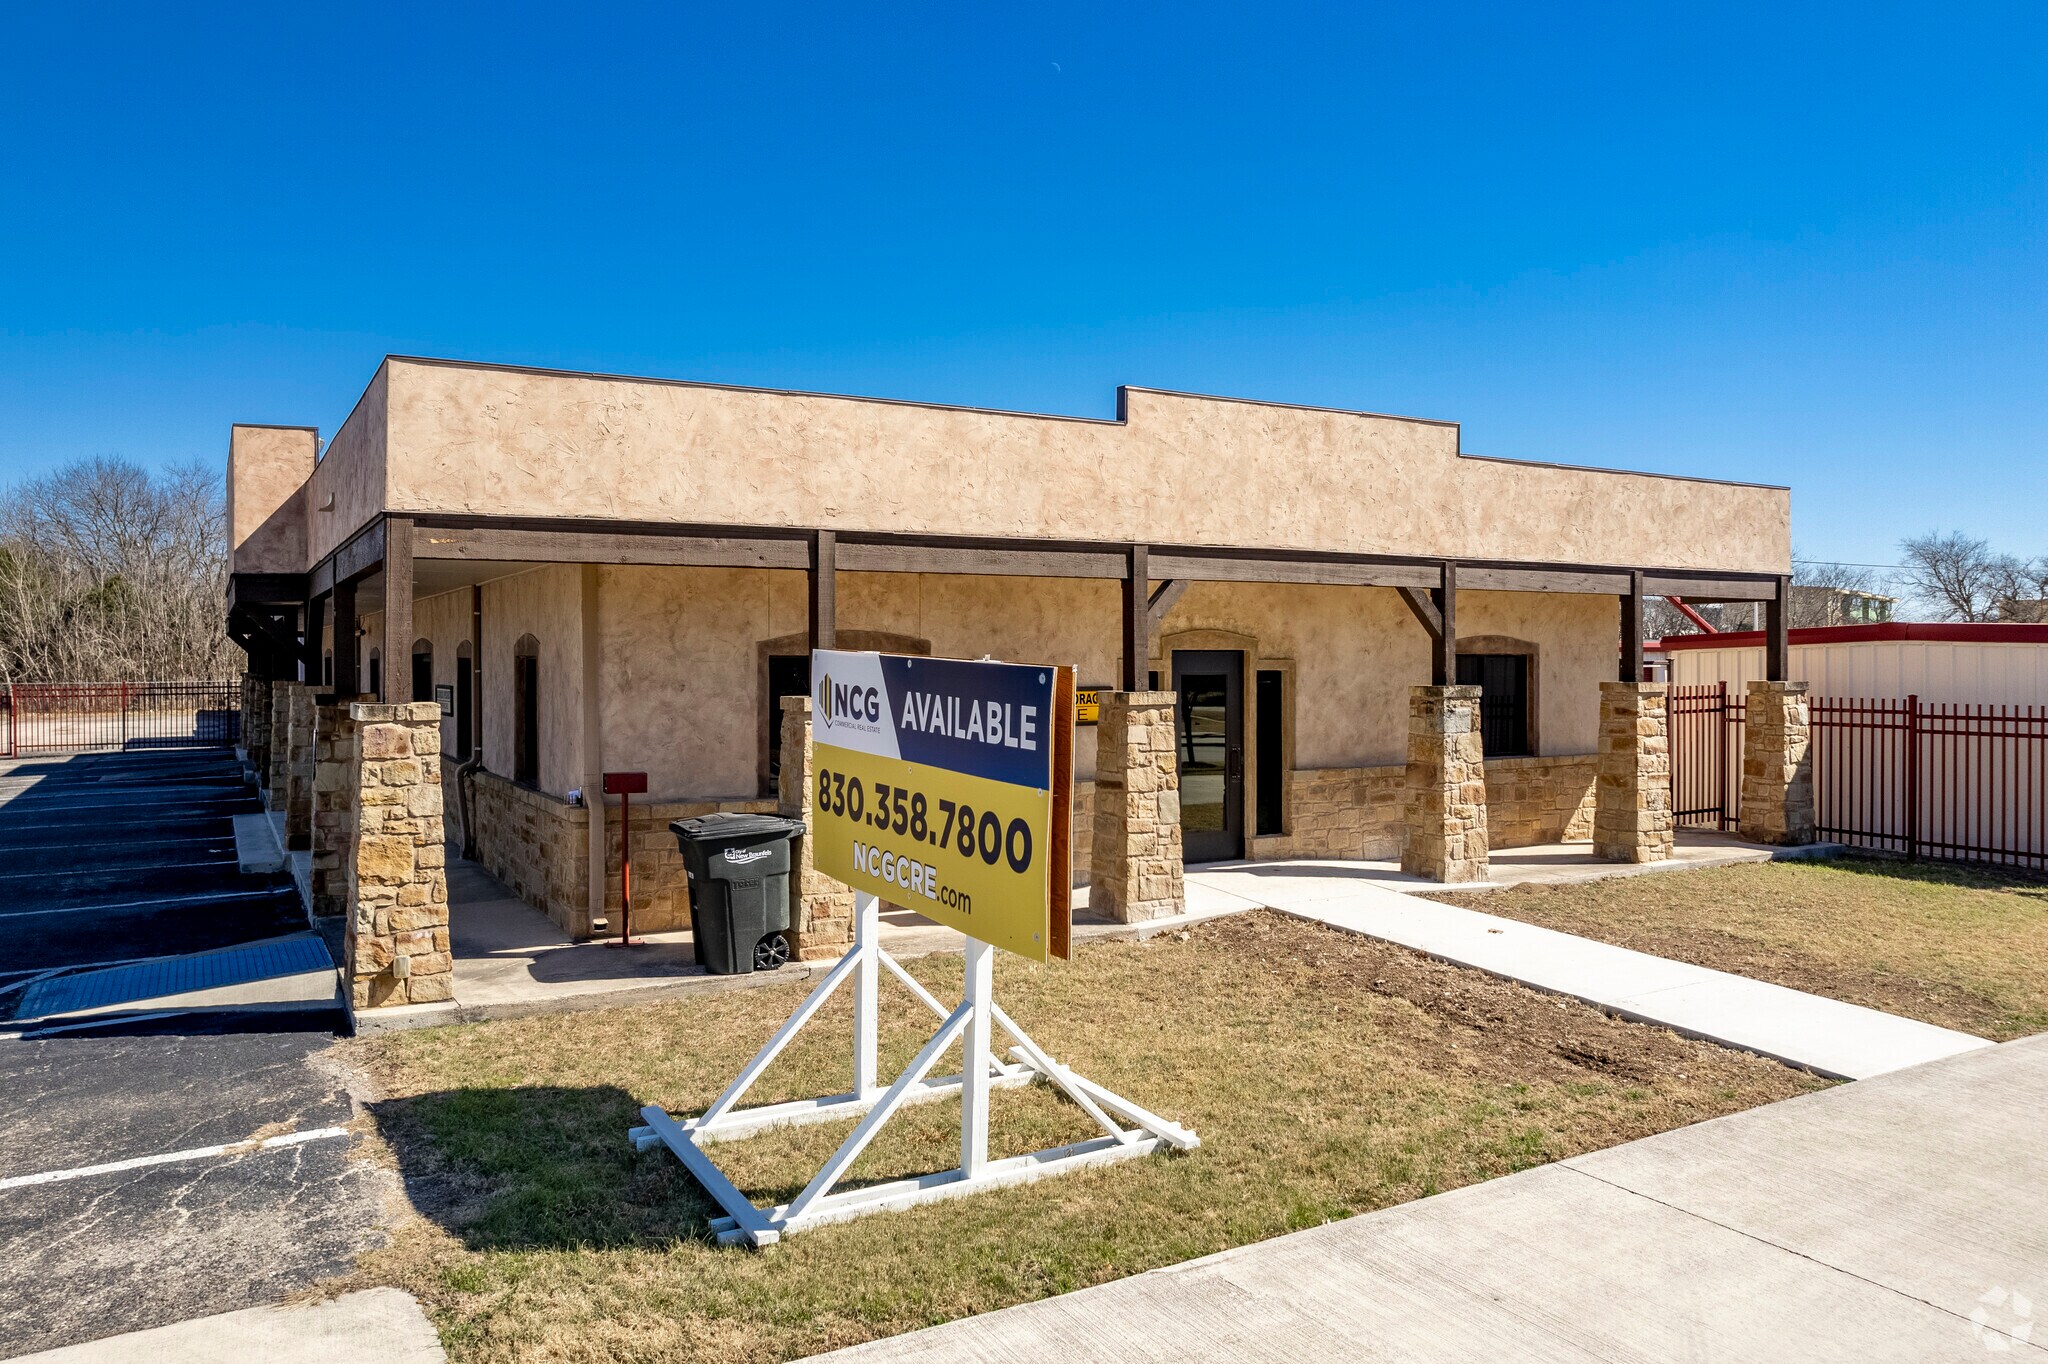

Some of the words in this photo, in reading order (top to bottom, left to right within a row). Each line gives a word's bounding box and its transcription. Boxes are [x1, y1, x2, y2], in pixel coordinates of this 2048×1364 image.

[835, 683, 880, 723] NCG
[867, 725, 880, 734] ESTATE
[901, 691, 1037, 751] AVAILABLE
[818, 768, 1033, 874] 830.358.7800
[853, 840, 972, 915] NCGCRE.com
